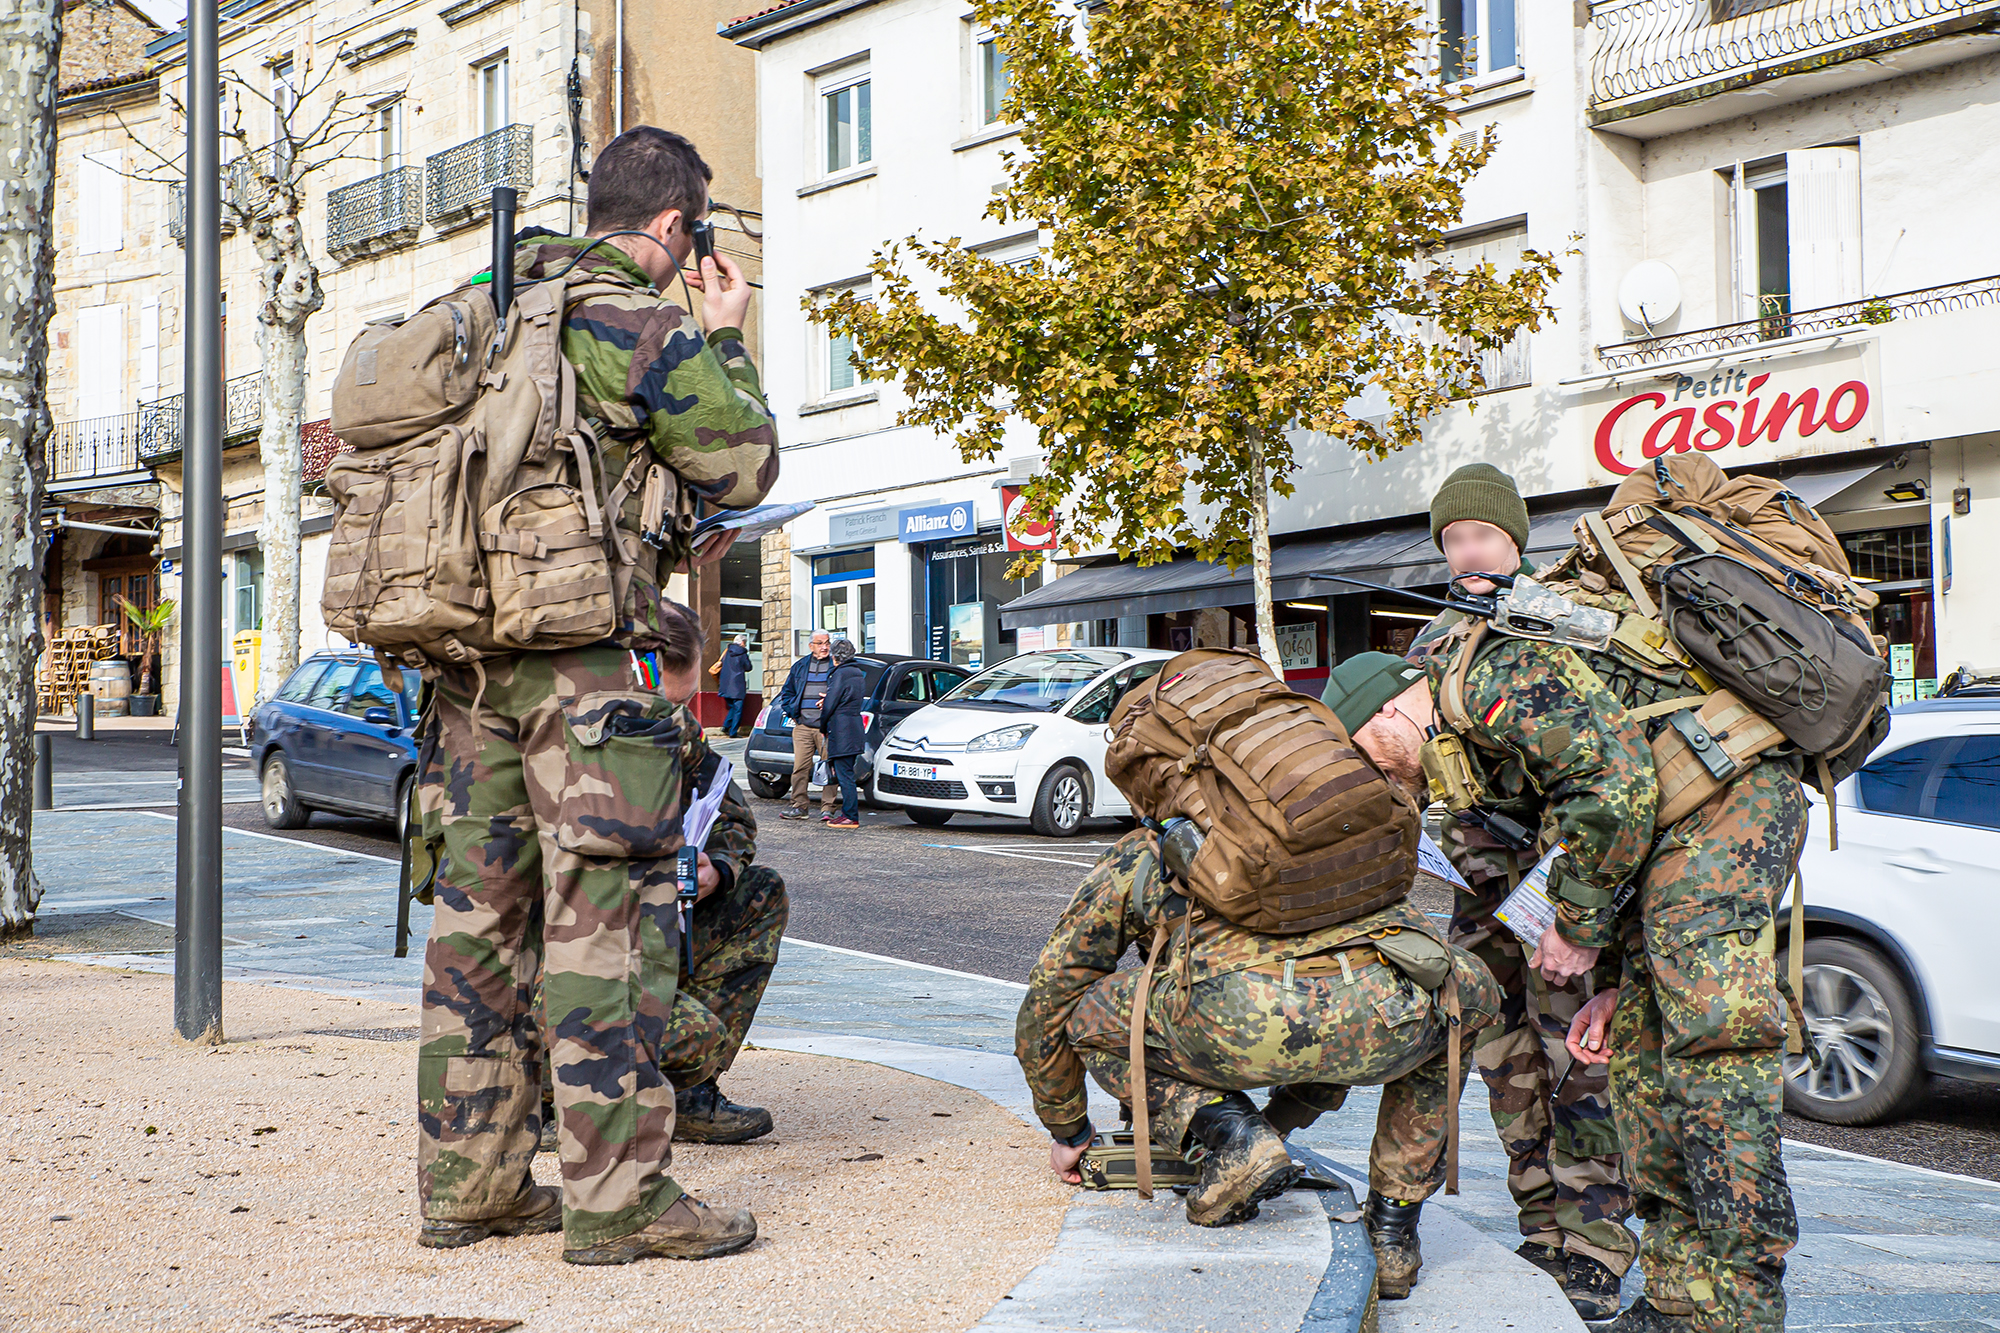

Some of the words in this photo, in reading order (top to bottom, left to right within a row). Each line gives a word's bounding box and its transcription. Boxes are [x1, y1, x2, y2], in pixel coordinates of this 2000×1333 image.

[1673, 368, 1748, 401] Petit
[1594, 372, 1870, 476] Casino
[845, 514, 865, 527] Patrick
[905, 514, 949, 534] Allianz
[845, 529, 859, 539] Agent
[931, 548, 968, 561] Assurances,
[968, 544, 987, 556] Santé
